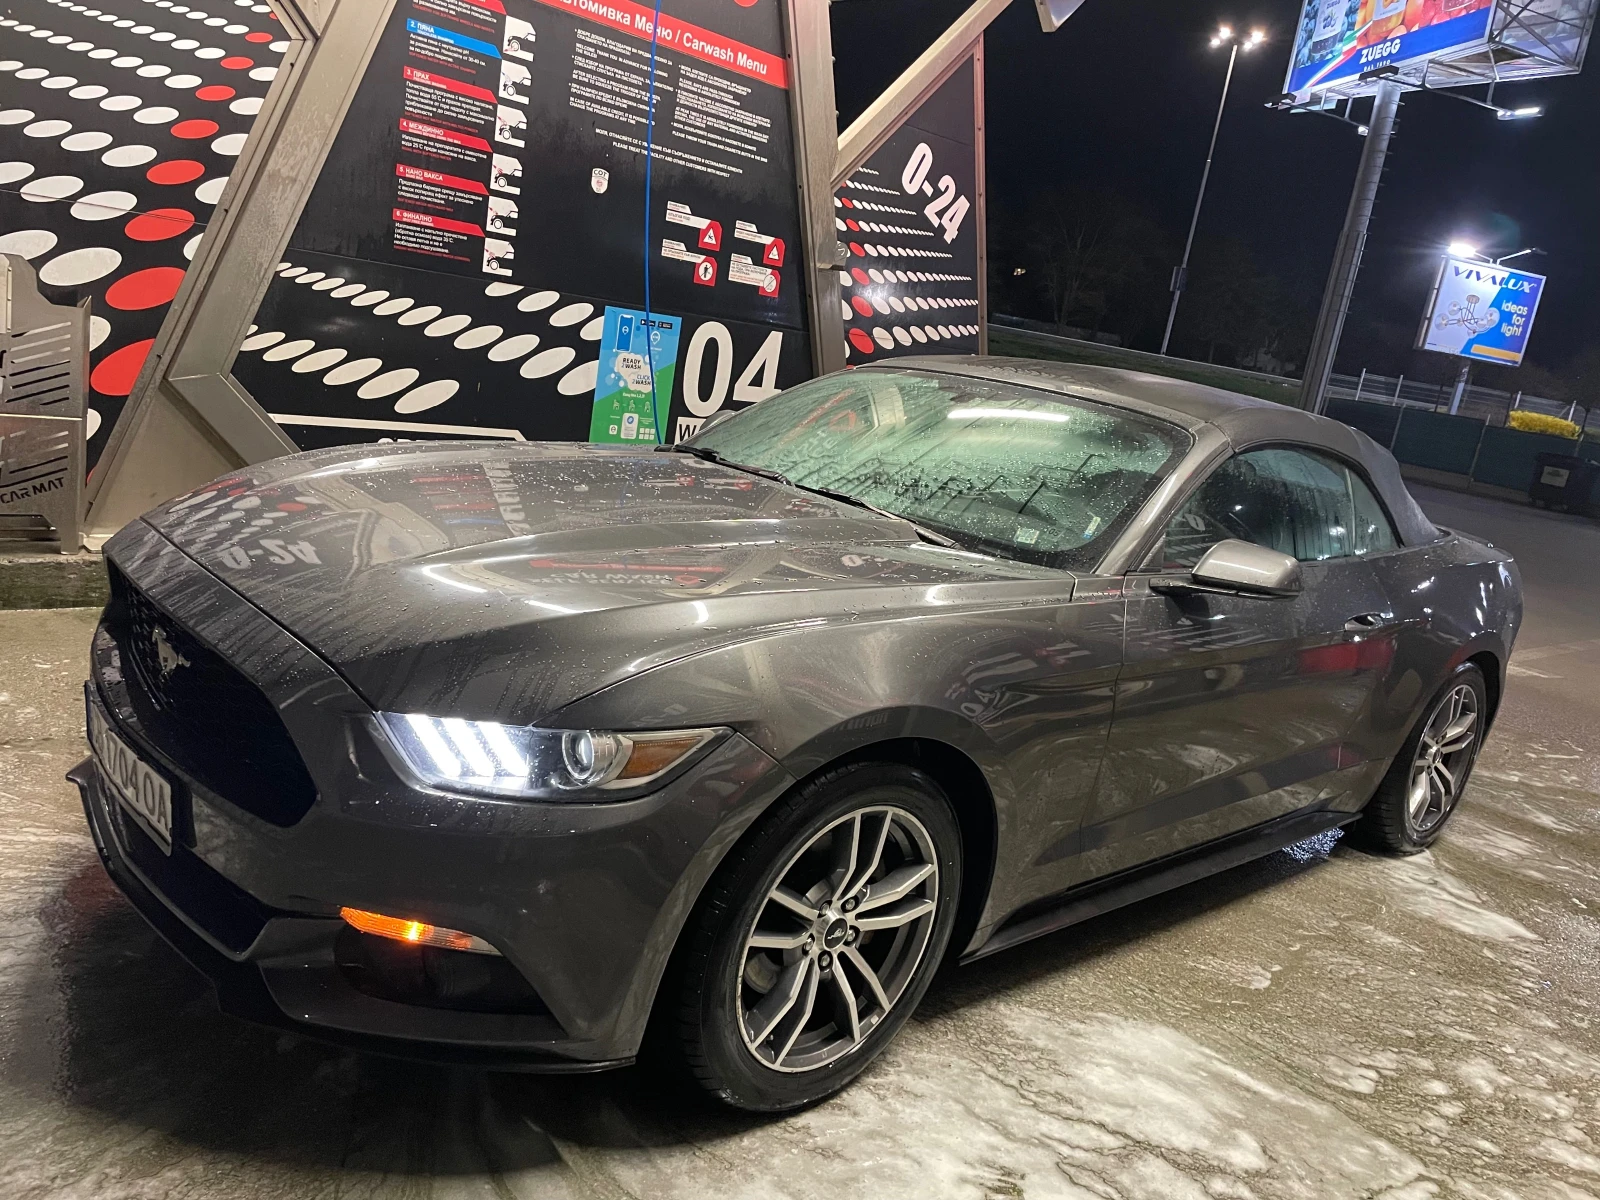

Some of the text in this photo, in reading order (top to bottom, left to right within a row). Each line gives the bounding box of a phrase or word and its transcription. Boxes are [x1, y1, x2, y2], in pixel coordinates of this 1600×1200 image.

[417, 23, 434, 33] ПЯНА
[683, 32, 734, 62] Carwash
[736, 52, 768, 75] Menu
[1359, 38, 1400, 64] ZUEGG
[413, 70, 429, 80] ПРАХ
[408, 122, 443, 135] МЕЖДИННО
[405, 167, 422, 176] НАНО
[423, 171, 442, 180] ВАКСА
[902, 142, 970, 244] 0-24
[402, 211, 432, 222] ФИНАЛНО
[1501, 300, 1528, 316] ideas
[1512, 314, 1526, 326] for
[1500, 323, 1522, 336] light
[683, 321, 783, 417] 04
[0, 477, 64, 504] CAR MAT
